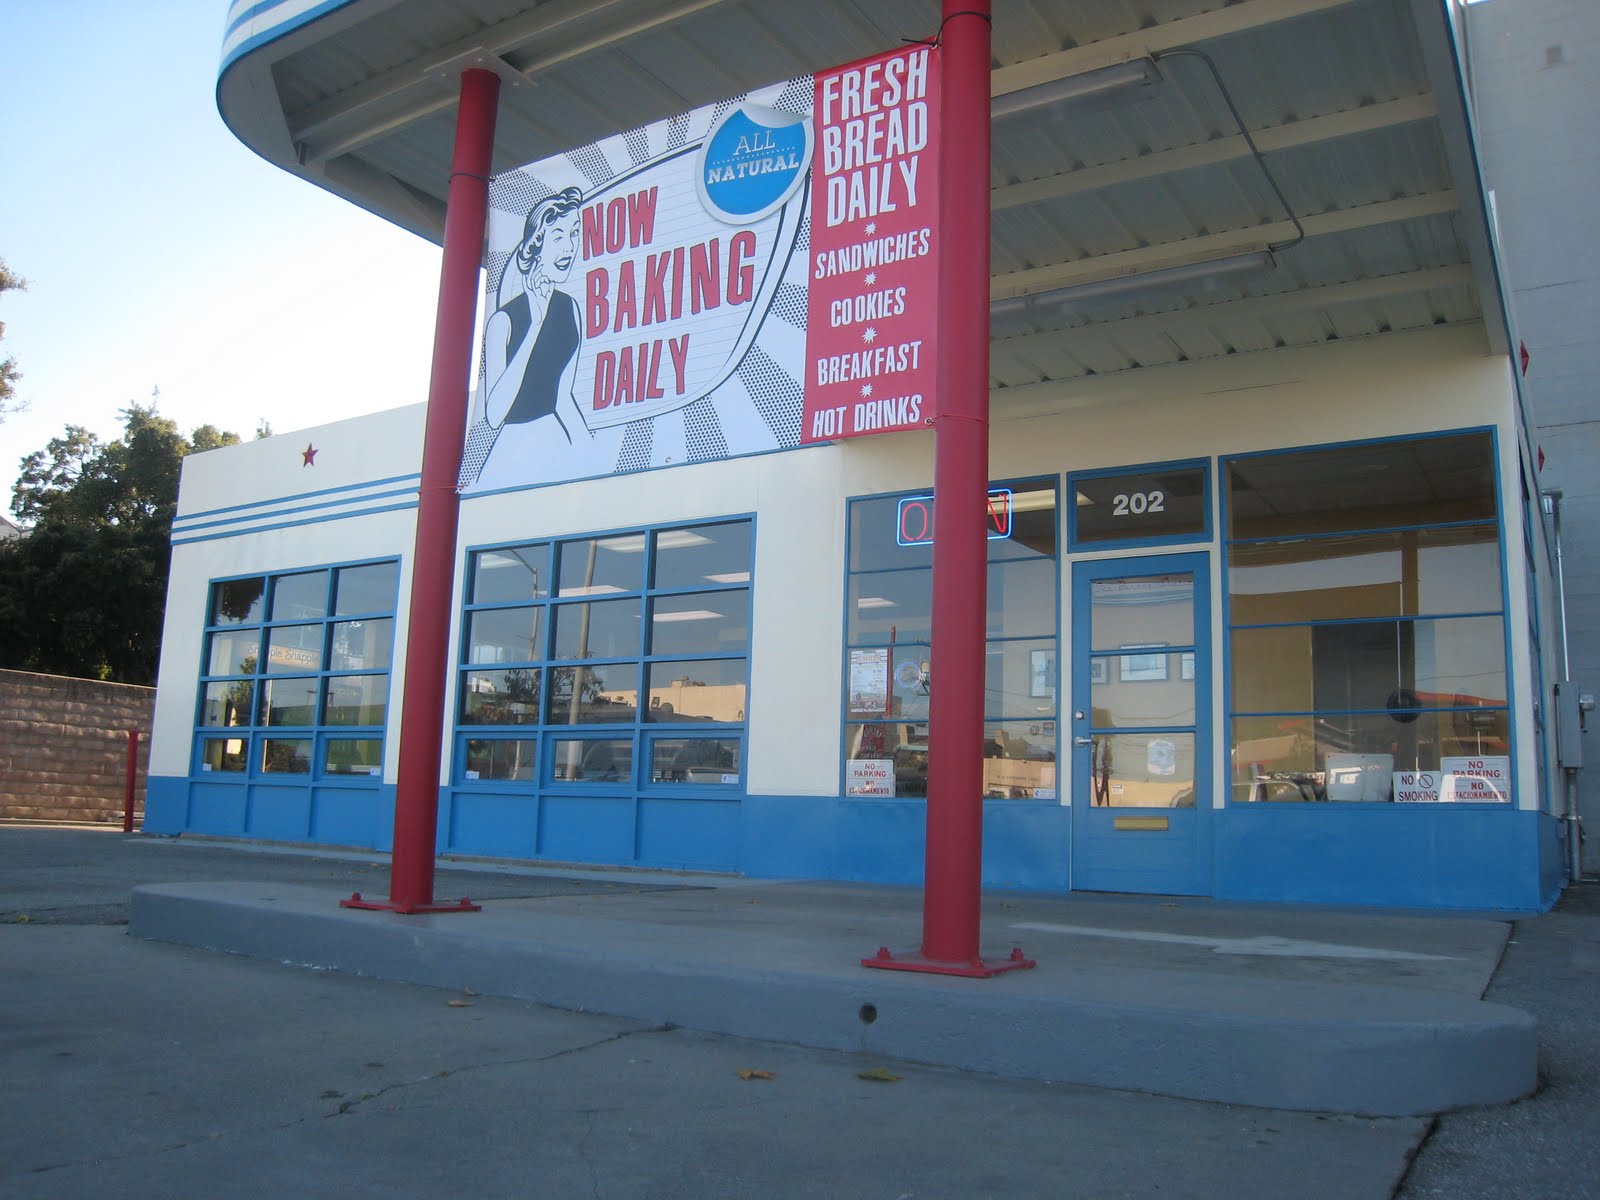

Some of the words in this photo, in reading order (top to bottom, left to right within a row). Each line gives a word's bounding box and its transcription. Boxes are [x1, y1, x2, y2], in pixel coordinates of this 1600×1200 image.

[823, 49, 929, 126] FRESH
[733, 130, 776, 156] ALL
[823, 101, 928, 176] BREAD
[707, 153, 800, 184] NATURAL
[826, 155, 918, 228] DAILY
[582, 186, 658, 261] NOW
[814, 227, 931, 280] SANDWICHES
[586, 230, 756, 339] BAKING
[830, 286, 906, 328] COOKIES
[593, 333, 690, 411] DAILY
[817, 340, 922, 386] BREAKFAST
[812, 406, 847, 438] HOT
[853, 394, 922, 433] DRINKS
[901, 493, 1008, 541] ON
[1113, 490, 1164, 516] 202
[854, 770, 887, 778] PARKING
[1401, 774, 1414, 786] NO
[1453, 769, 1501, 778] PARKING
[1468, 760, 1484, 769] NO
[1471, 782, 1484, 790] NO
[1398, 790, 1439, 802] SMOKING
